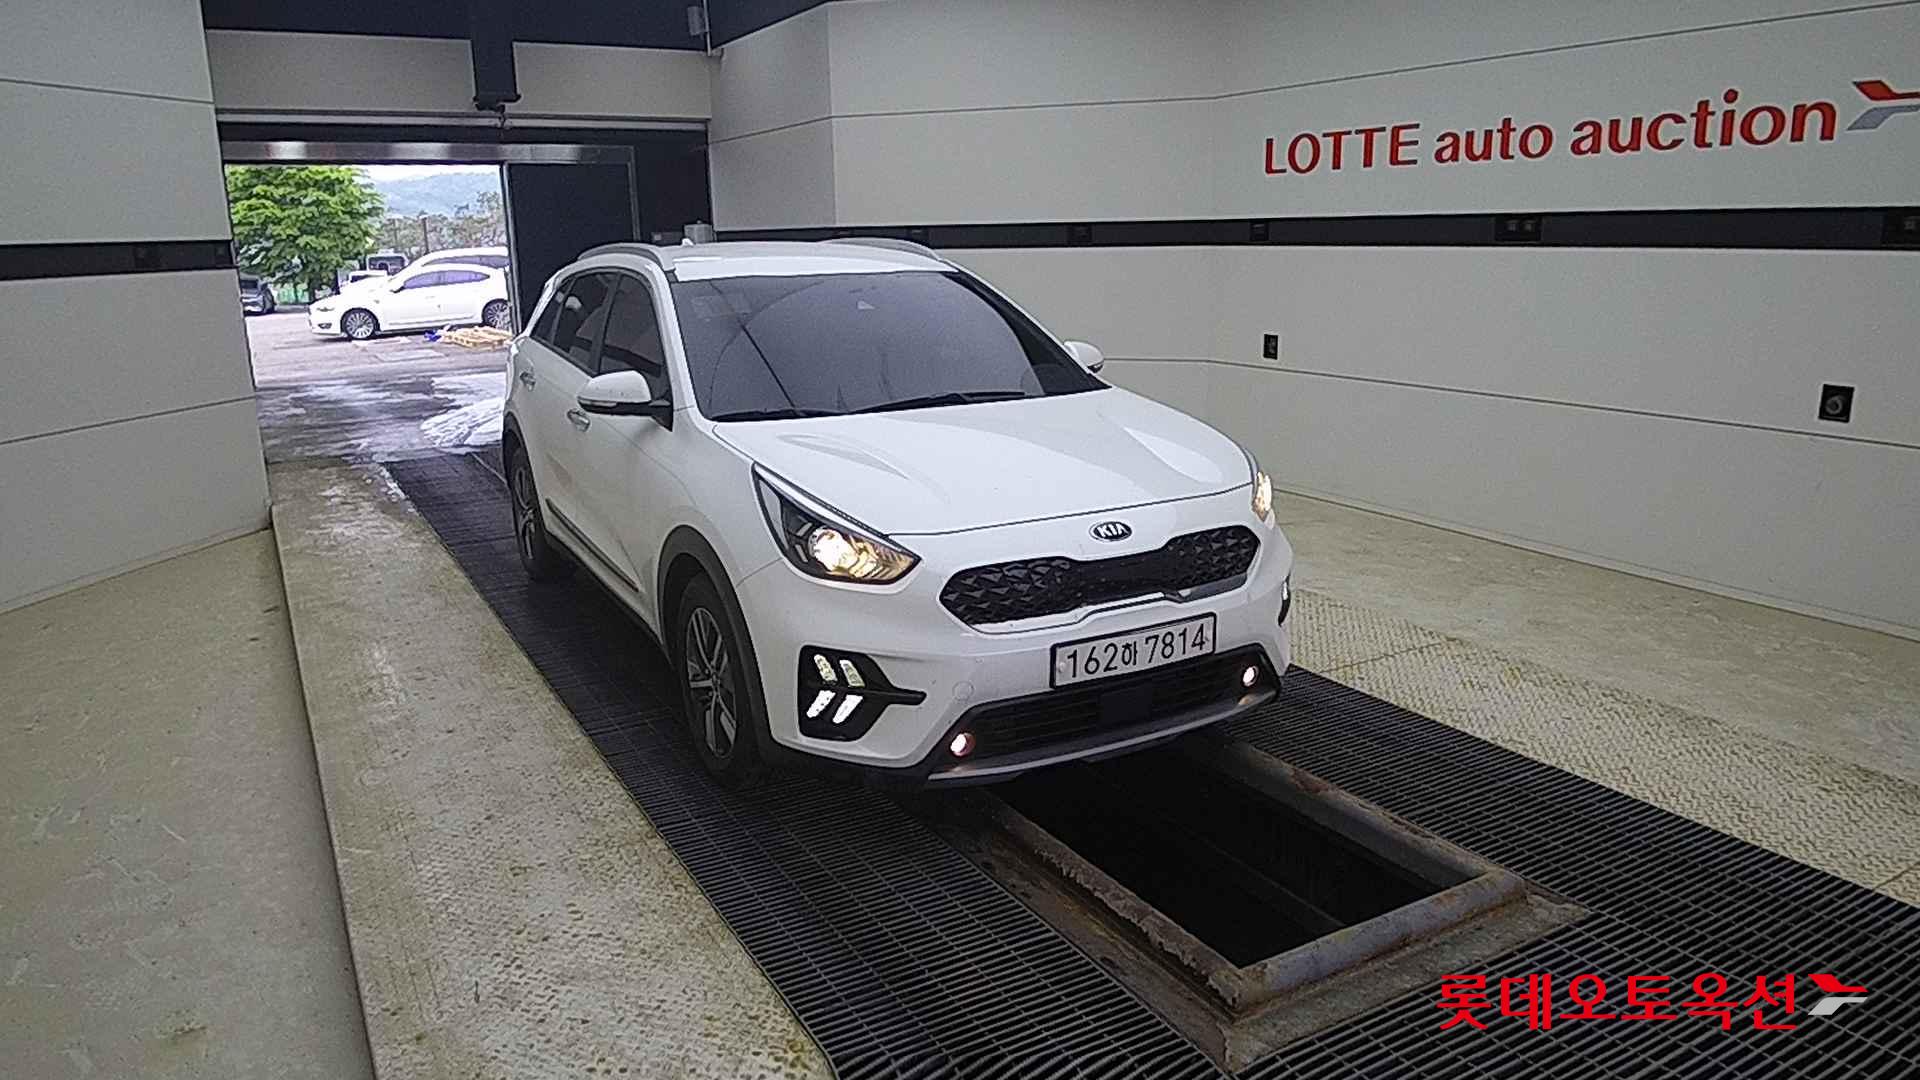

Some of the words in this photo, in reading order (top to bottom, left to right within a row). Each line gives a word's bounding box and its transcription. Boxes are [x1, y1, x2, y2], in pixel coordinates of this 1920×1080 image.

[1265, 122, 1421, 175] LOTTE
[1433, 117, 1554, 164] auto
[1570, 88, 1837, 156] auction
[1096, 523, 1129, 537] KIA
[1145, 623, 1206, 663] 7814
